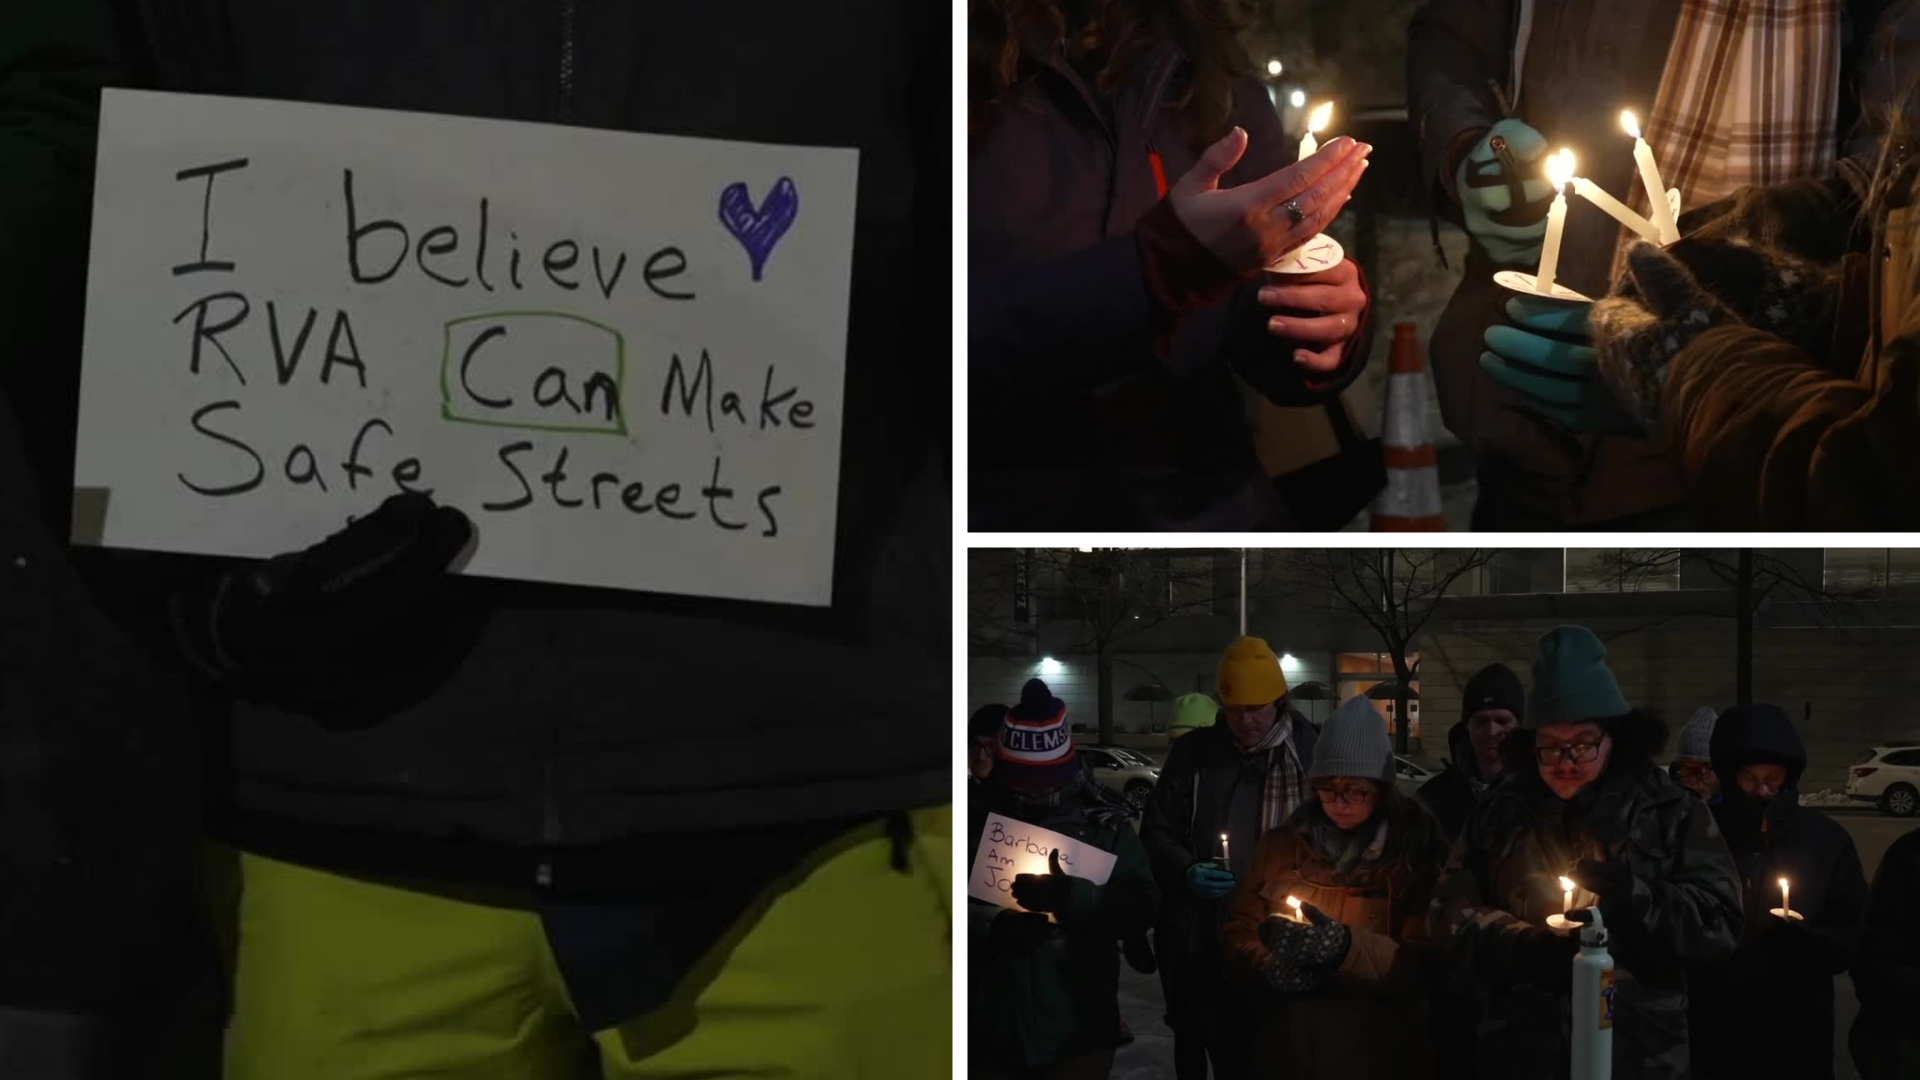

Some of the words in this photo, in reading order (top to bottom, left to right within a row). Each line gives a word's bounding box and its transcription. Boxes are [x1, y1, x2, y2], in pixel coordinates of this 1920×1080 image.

[172, 158, 249, 277] I
[343, 168, 698, 301] believe
[172, 290, 368, 388] RVA
[458, 325, 619, 421] Can
[661, 348, 816, 432] Make
[177, 399, 436, 497] Safe
[481, 440, 783, 538] Streets
[989, 821, 1074, 866] Barbaa
